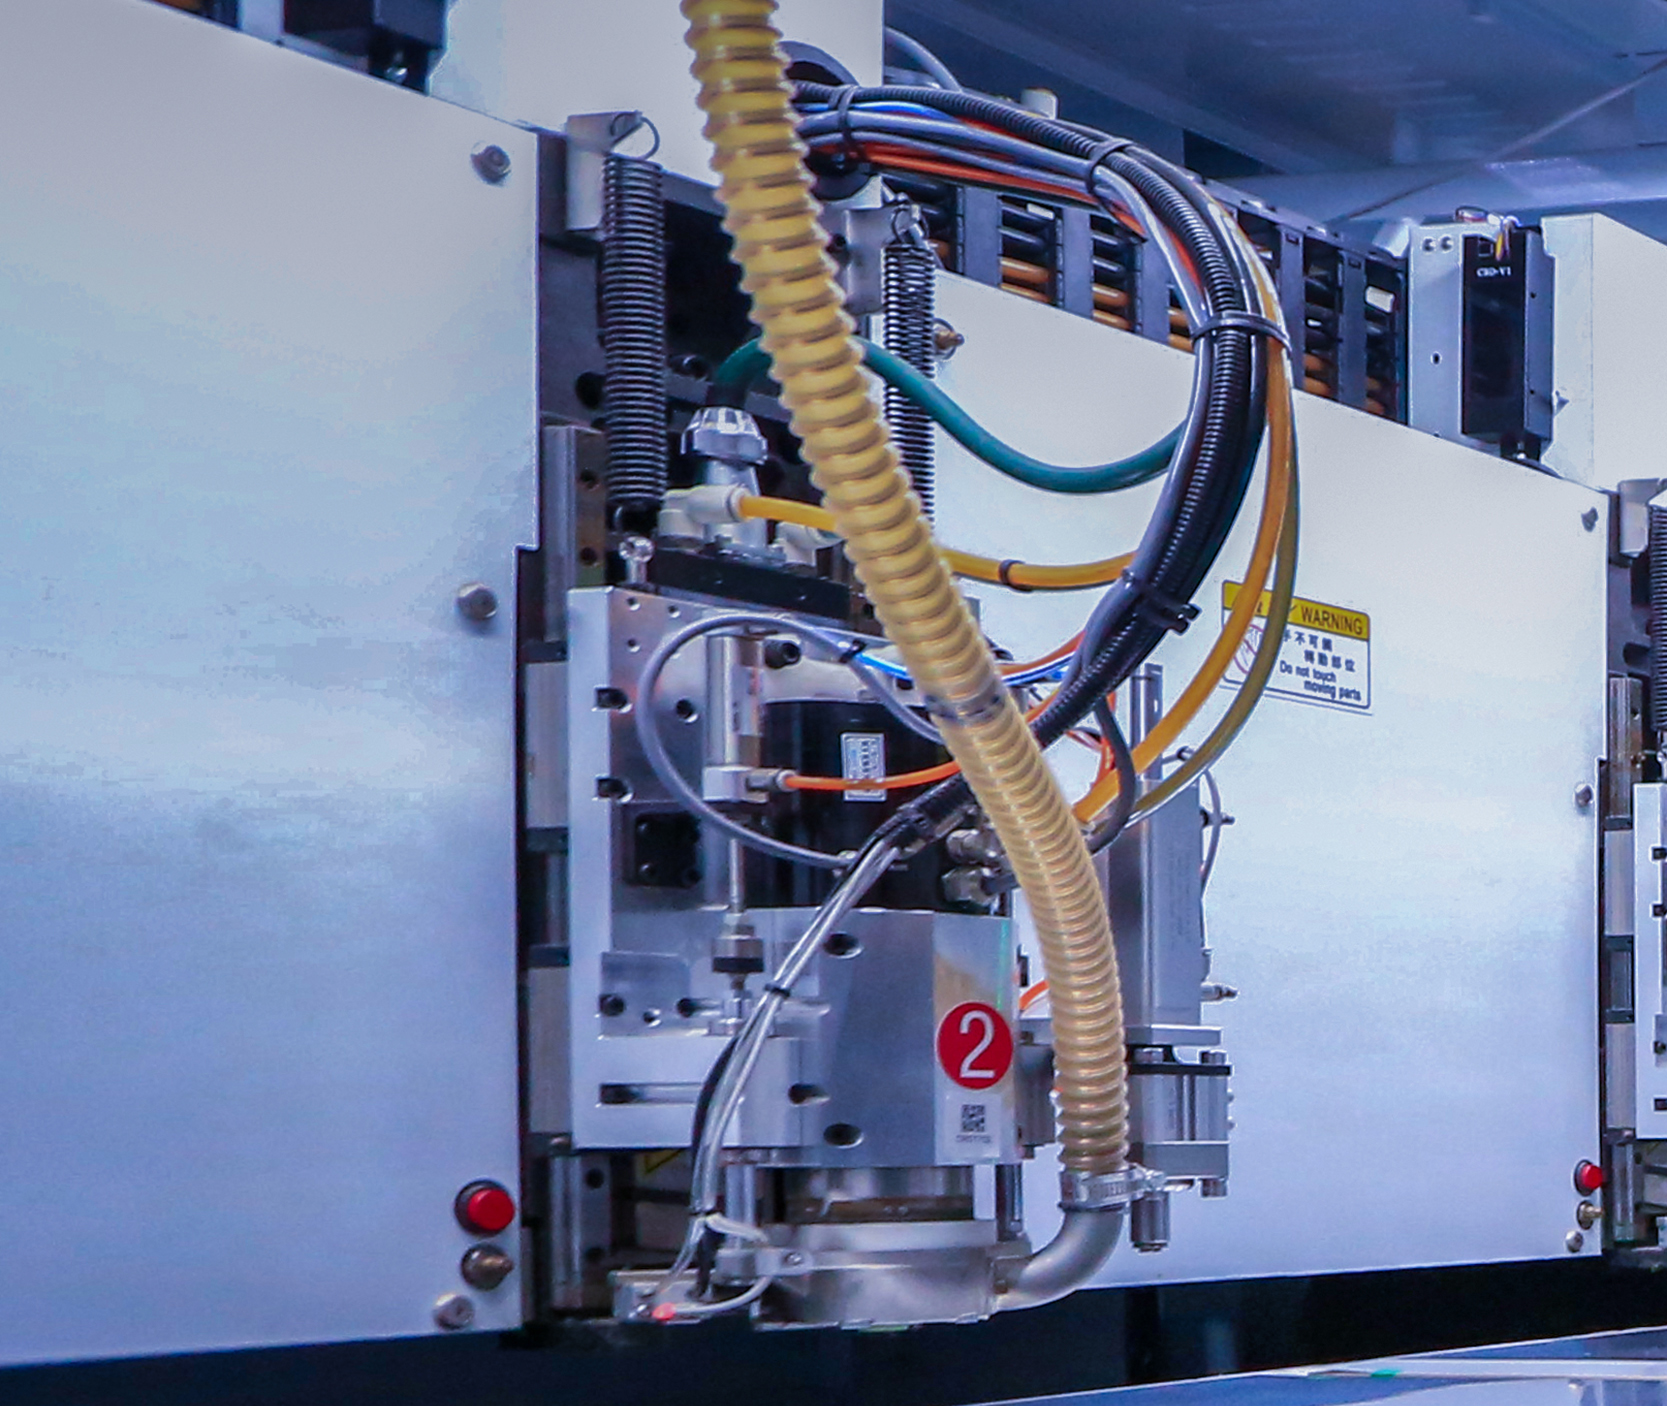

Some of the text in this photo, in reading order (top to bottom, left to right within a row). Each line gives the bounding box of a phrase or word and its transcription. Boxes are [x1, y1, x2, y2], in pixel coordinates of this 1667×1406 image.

[1301, 604, 1363, 635] WARNING
[1279, 660, 1337, 683] Do not touch
[1304, 680, 1362, 701] moving parts
[959, 1010, 995, 1078] 2
